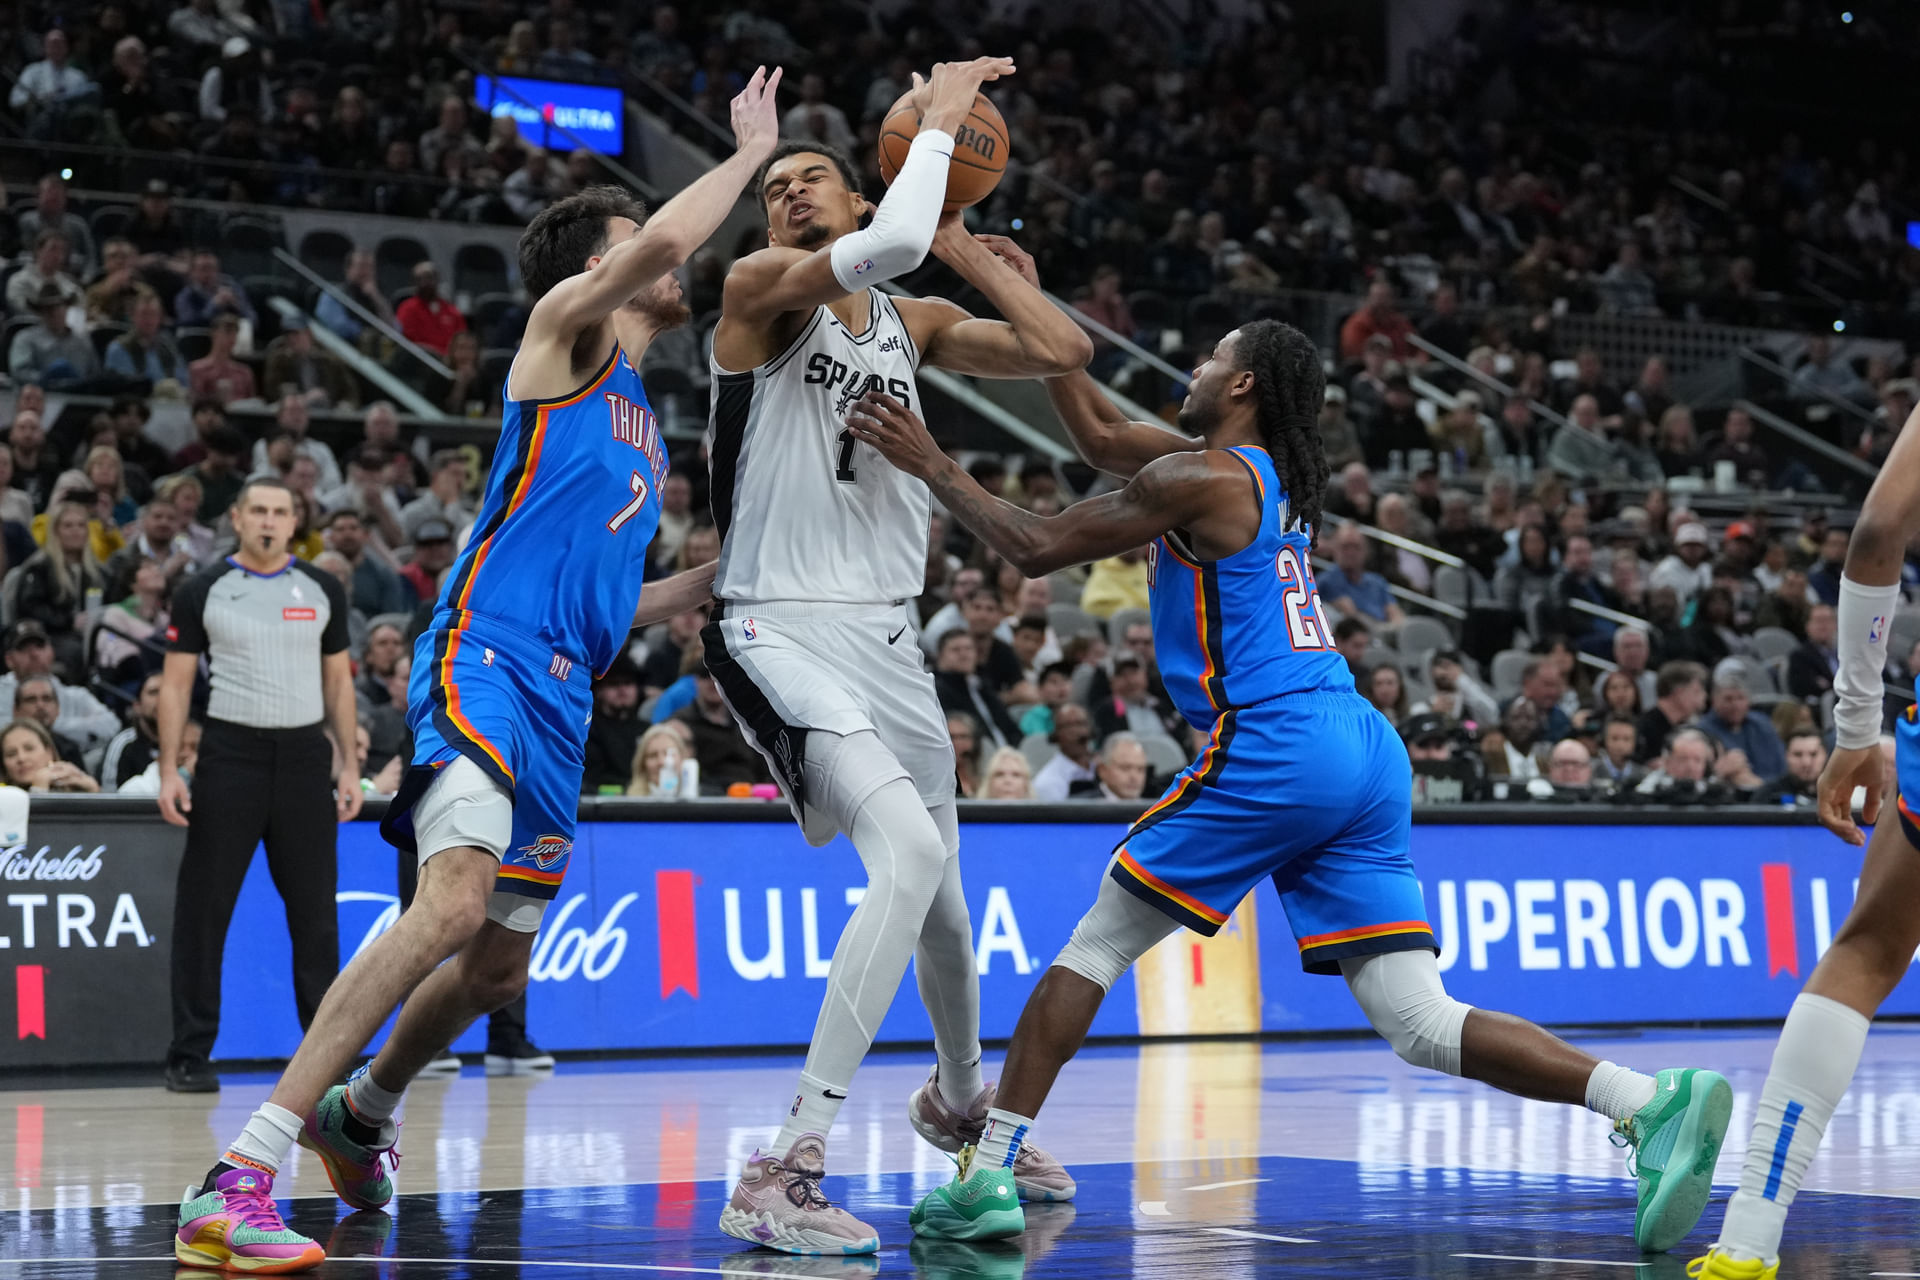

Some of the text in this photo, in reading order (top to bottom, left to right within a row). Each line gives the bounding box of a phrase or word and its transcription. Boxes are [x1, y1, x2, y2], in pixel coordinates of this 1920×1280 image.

[834, 426, 858, 484] 1
[606, 469, 649, 535] 7
[549, 652, 573, 682] OKC
[0, 893, 151, 949] TRA
[723, 886, 1033, 981] ULA
[1417, 876, 1752, 973] UPERIOR
